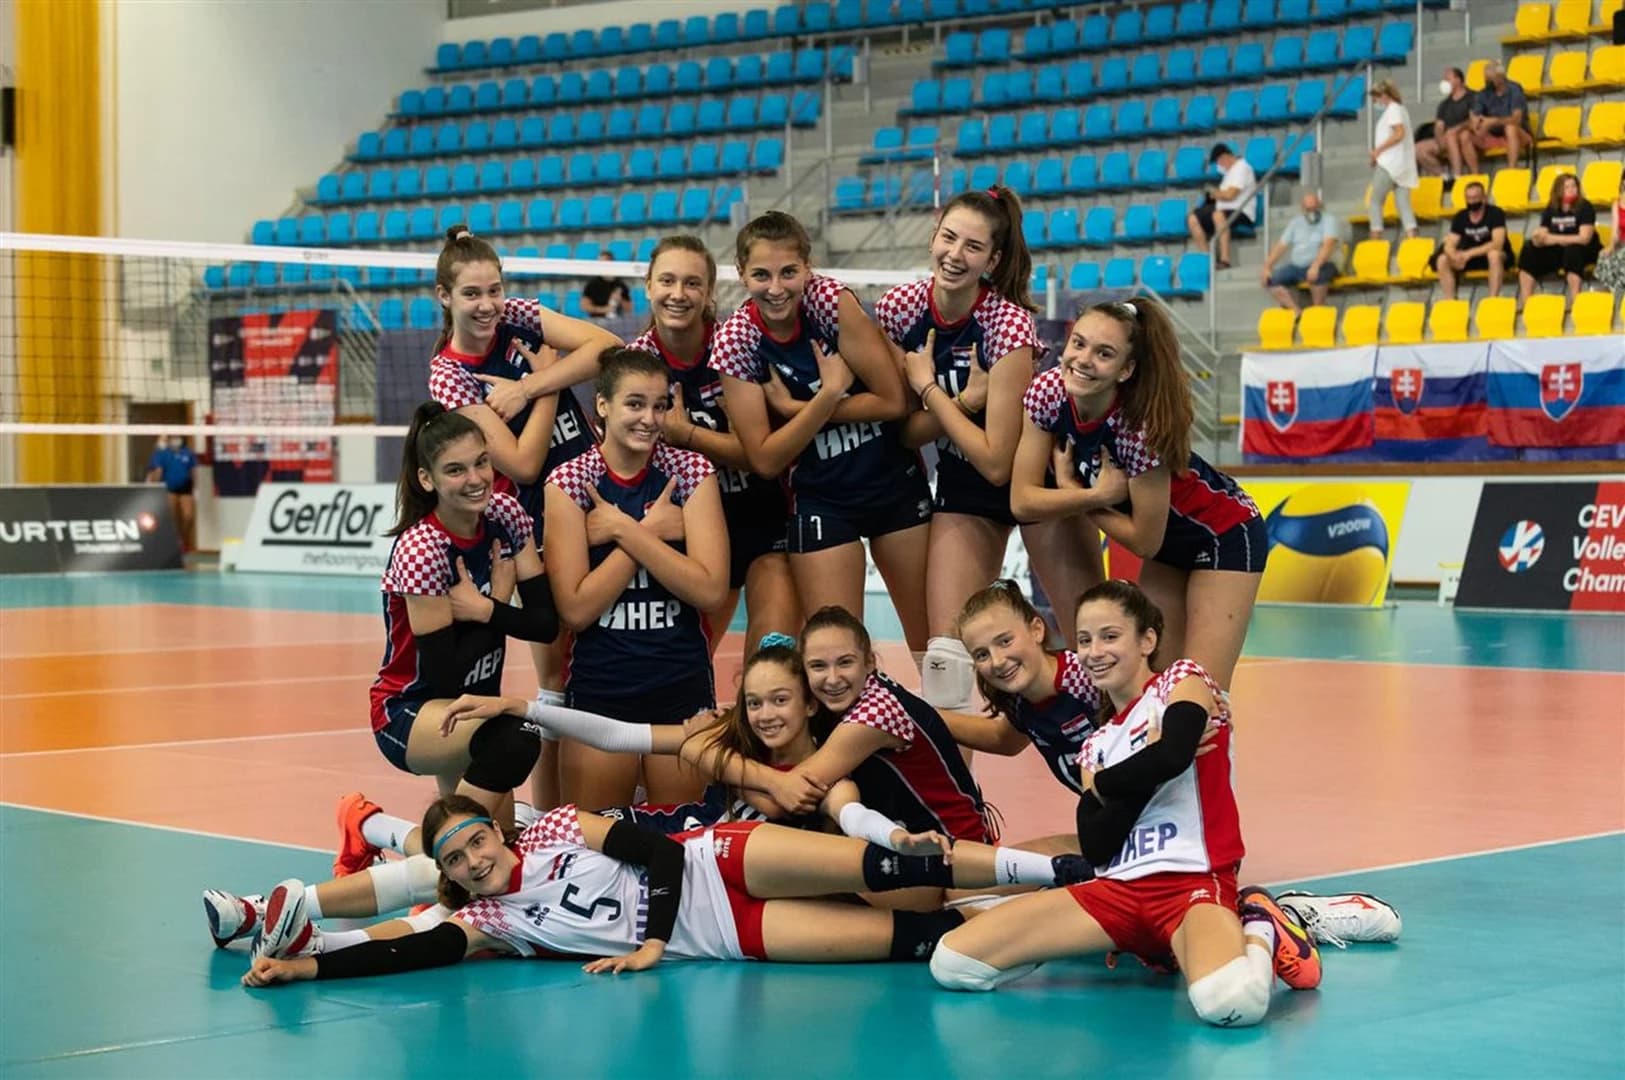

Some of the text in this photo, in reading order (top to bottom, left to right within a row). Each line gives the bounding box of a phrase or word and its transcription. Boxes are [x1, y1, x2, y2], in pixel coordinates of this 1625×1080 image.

[269, 489, 383, 542] Gerflor
[810, 515, 822, 541] 7
[1578, 503, 1625, 528] CEV
[0, 520, 140, 543] URTEEN
[1563, 567, 1625, 592] Cham
[627, 600, 681, 630] HEP
[560, 883, 621, 921] 5
